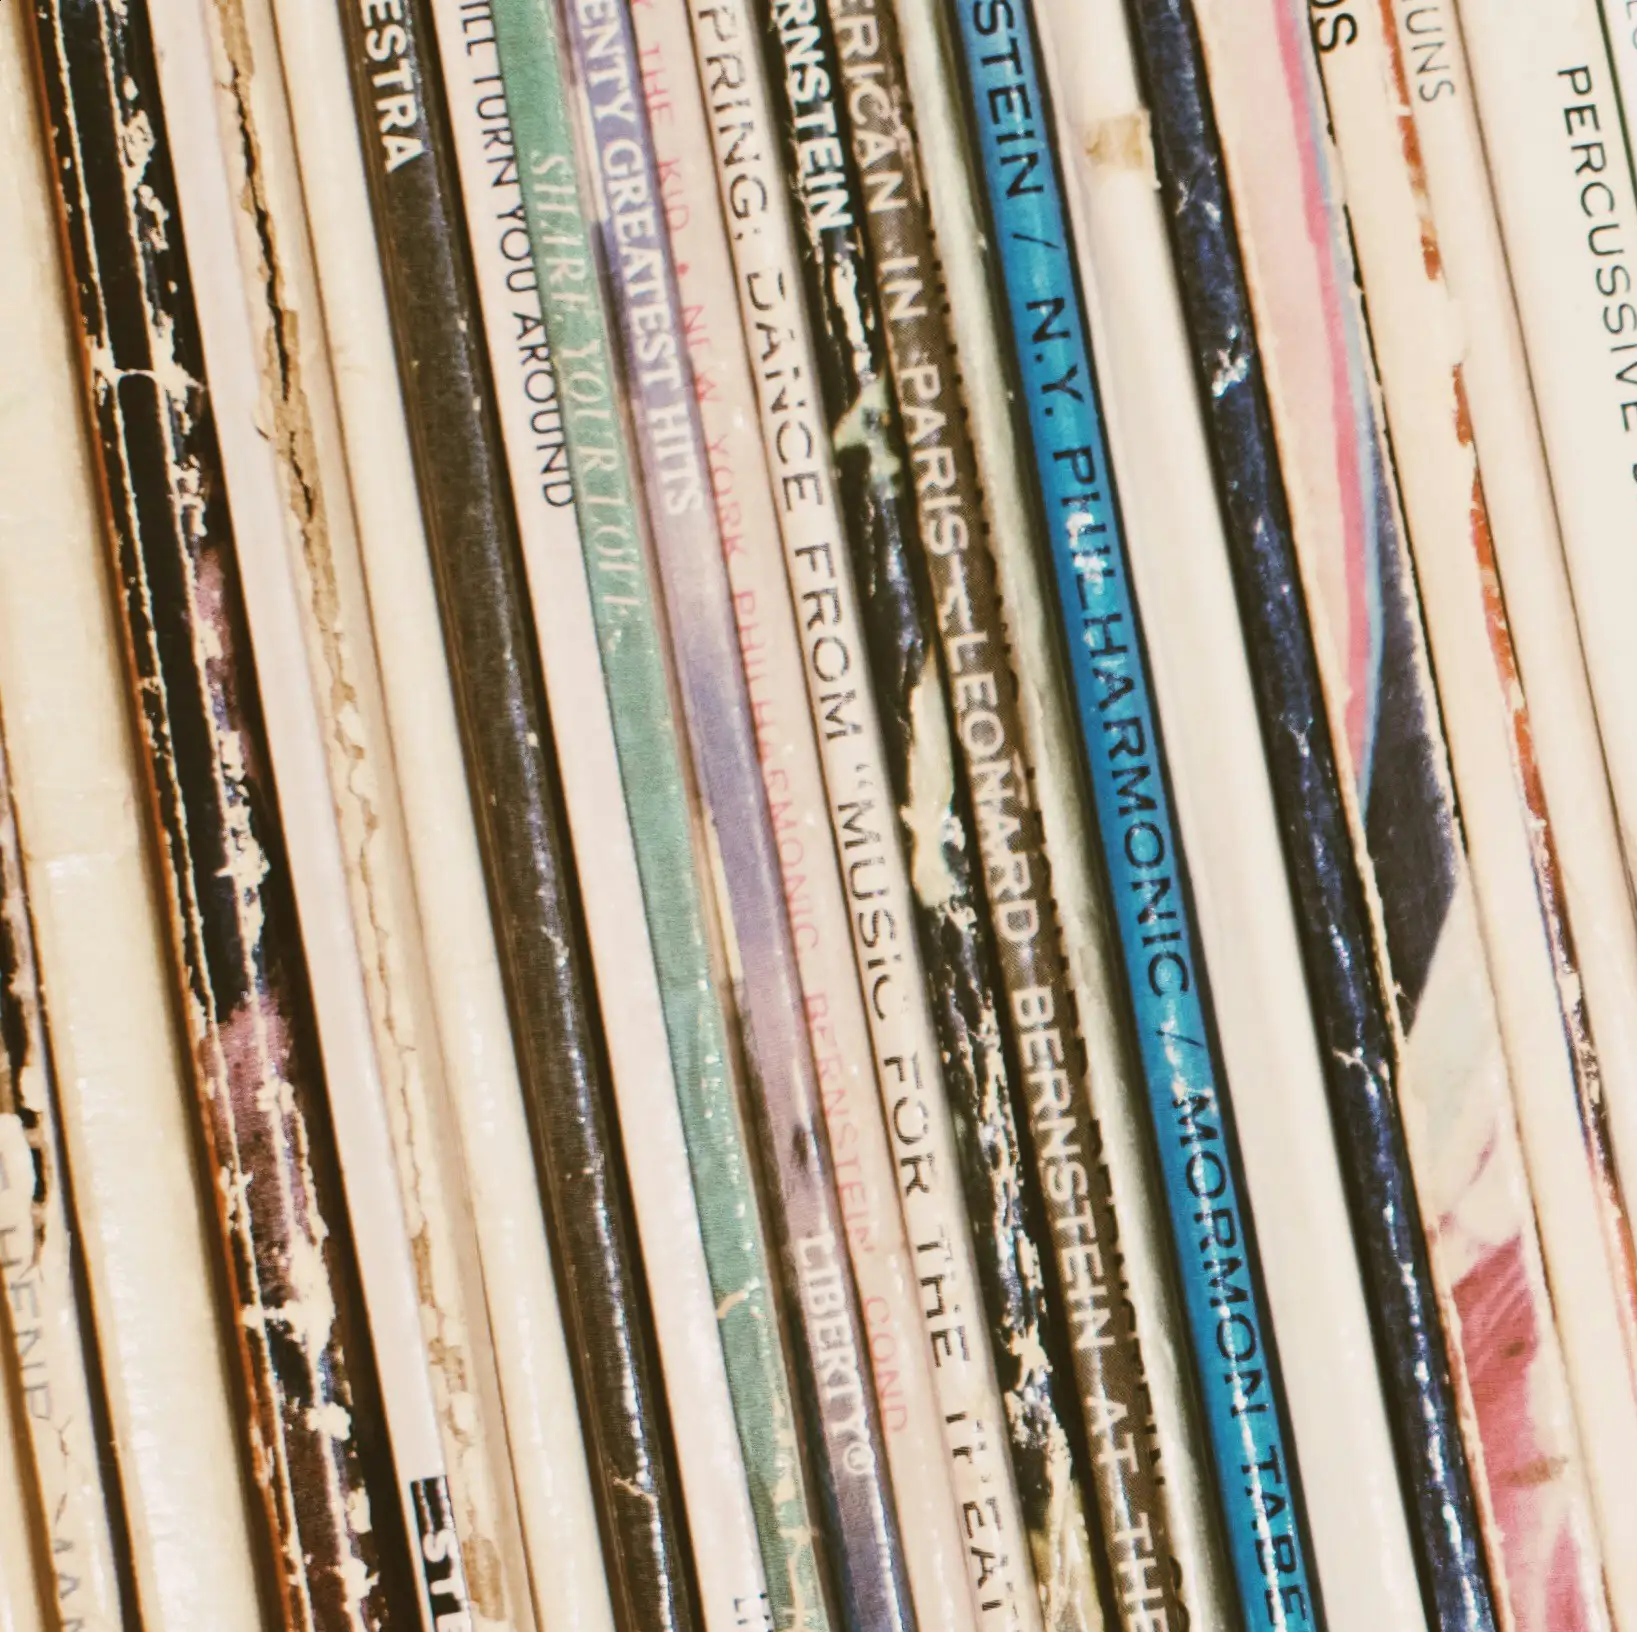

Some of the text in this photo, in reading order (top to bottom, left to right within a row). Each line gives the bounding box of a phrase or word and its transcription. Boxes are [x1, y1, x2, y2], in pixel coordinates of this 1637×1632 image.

[357, 0, 429, 173] ESTRA
[470, 74, 521, 188] TURN
[492, 201, 540, 294] YOU
[598, 138, 685, 392] GREATEST
[645, 403, 707, 515] HITS
[511, 311, 577, 508] AROUND
[743, 269, 826, 512] DANCE
[1021, 297, 1088, 417] N.Y.
[789, 543, 866, 741] FROM
[1048, 449, 1196, 999] PHILHARMONIC
[875, 253, 931, 321] IN
[1007, 986, 1119, 1349] BERNSTEIN
[1083, 1394, 1142, 1473] AT
[879, 1054, 945, 1198] FOR
[911, 1237, 974, 1368] THE
[1168, 1090, 1272, 1419] MORMON
